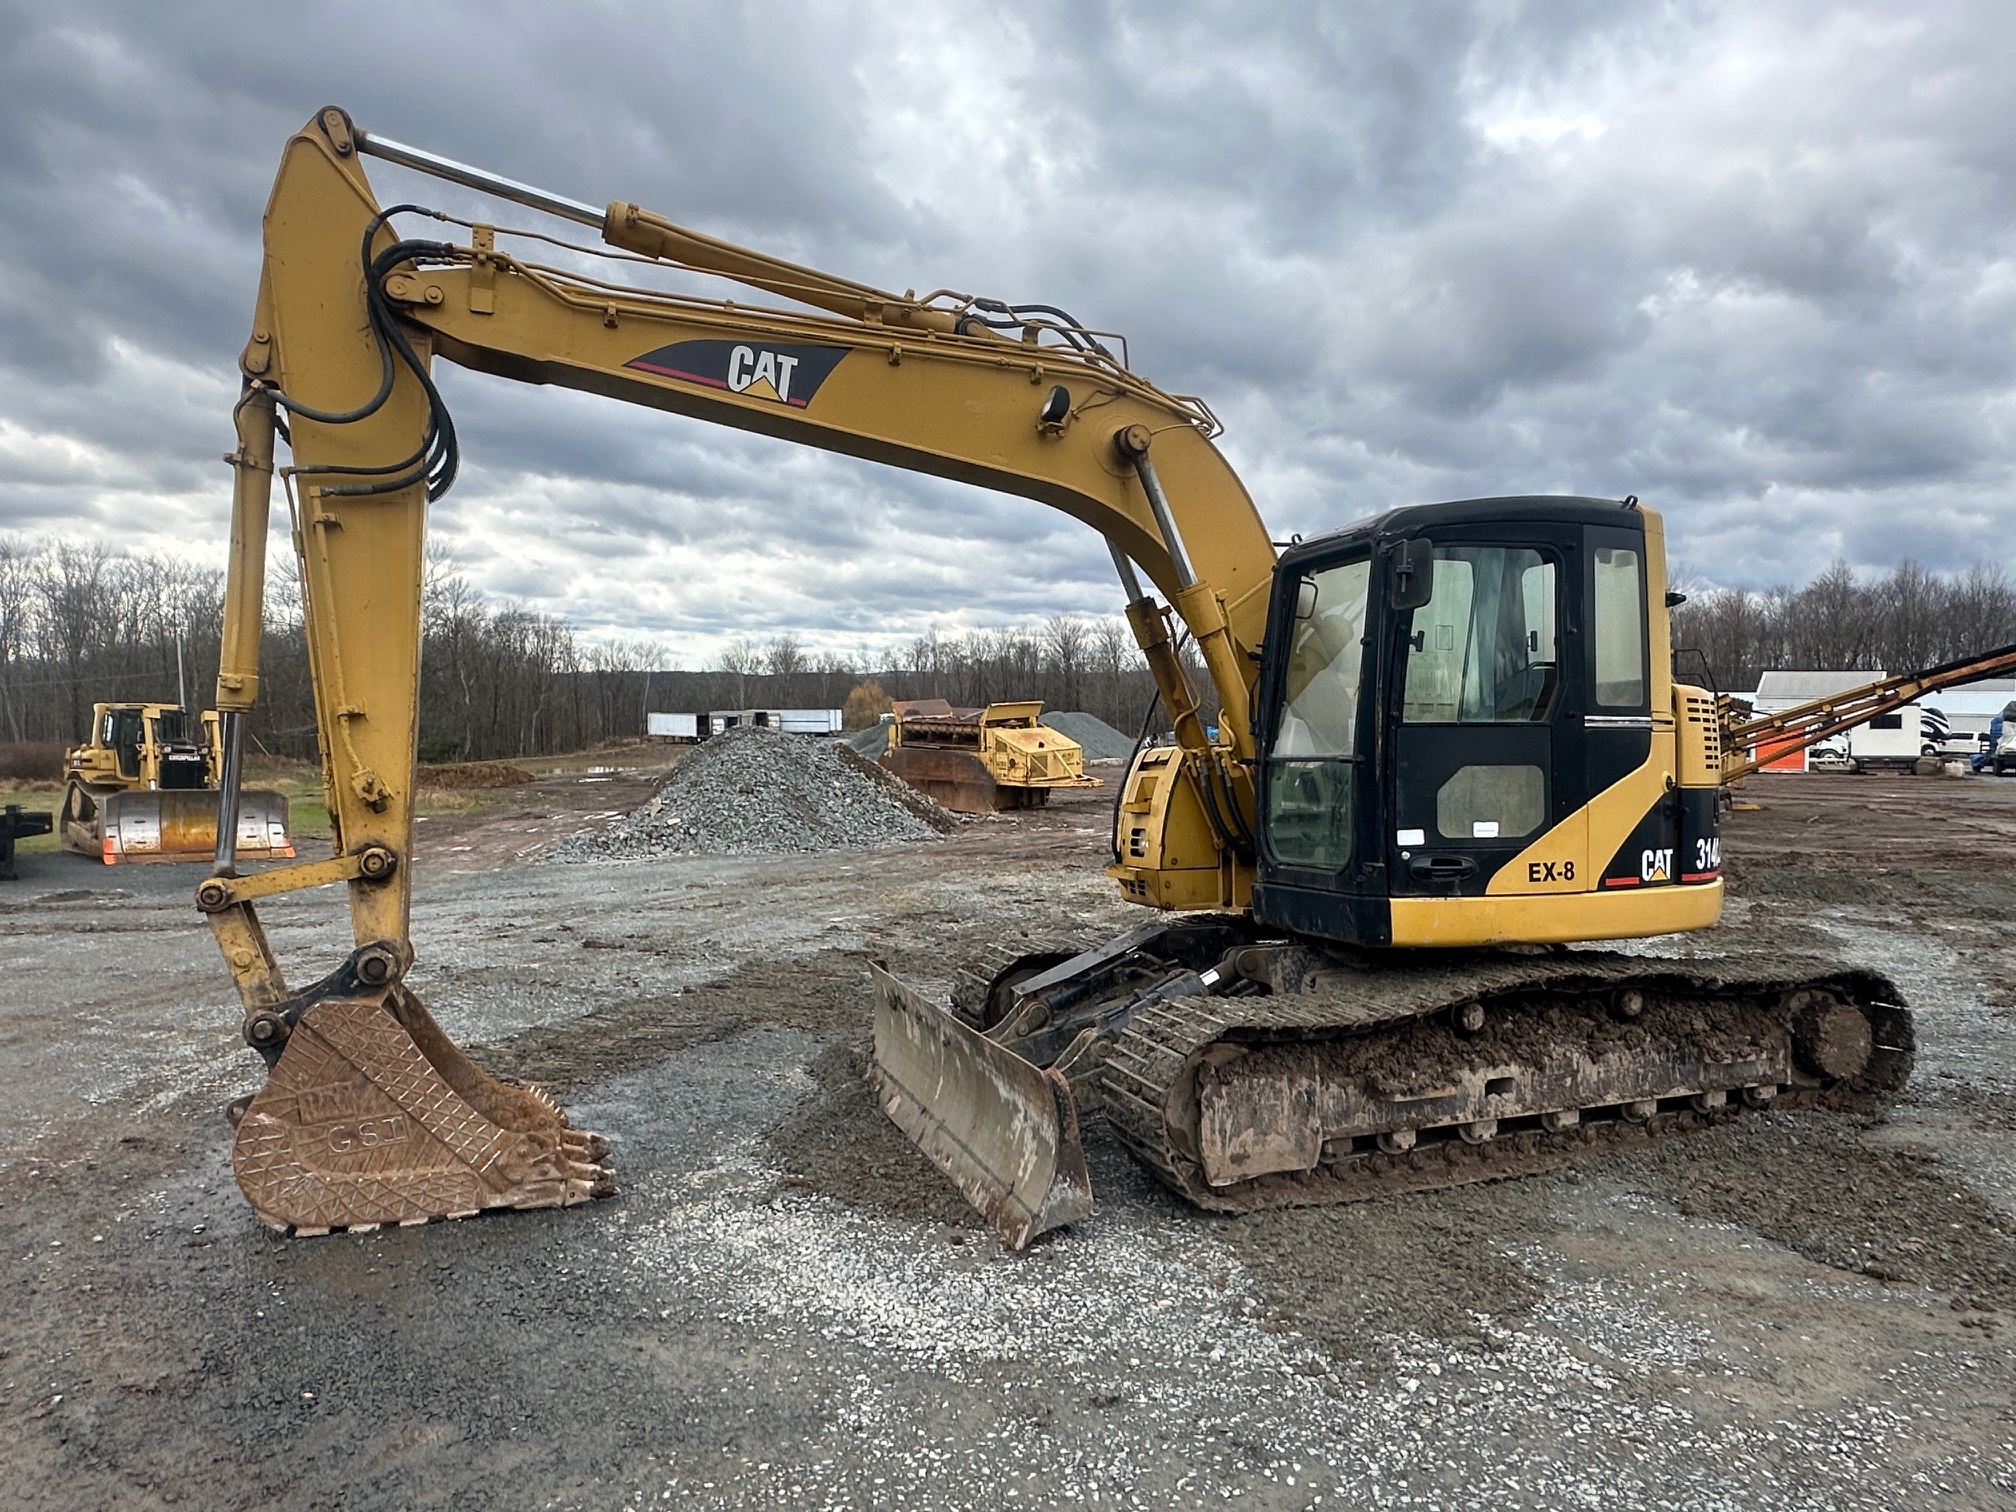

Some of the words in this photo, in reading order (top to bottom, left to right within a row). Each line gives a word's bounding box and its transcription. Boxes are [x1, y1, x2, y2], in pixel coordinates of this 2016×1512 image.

[727, 344, 799, 403] CAT
[1528, 861, 1575, 883] EX-8
[1641, 848, 1673, 882] CAT
